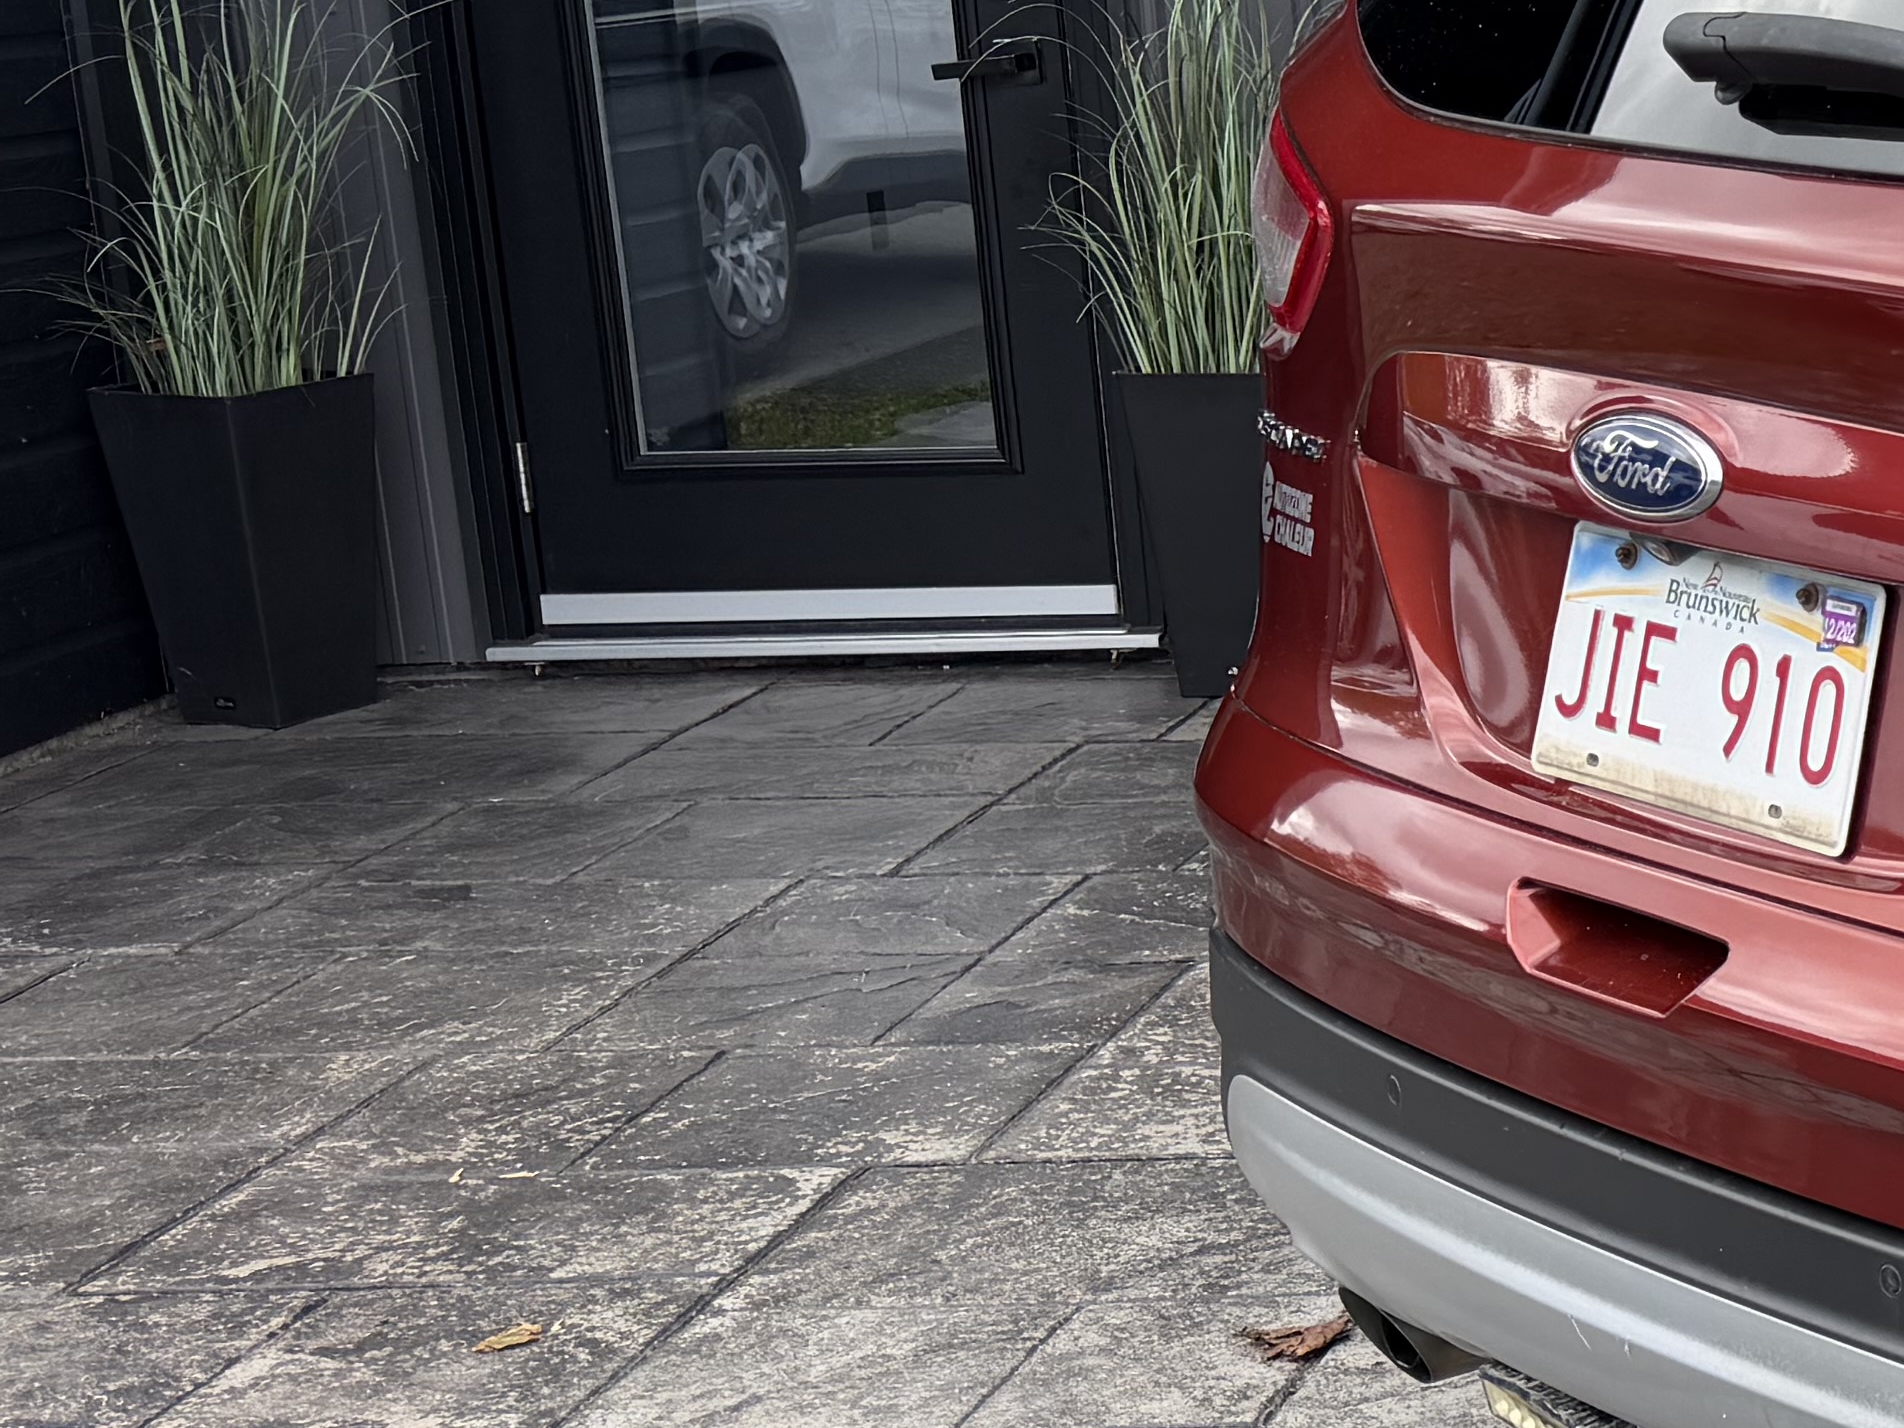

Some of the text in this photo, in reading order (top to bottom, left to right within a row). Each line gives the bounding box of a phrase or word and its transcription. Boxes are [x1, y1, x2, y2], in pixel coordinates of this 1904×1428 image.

[1593, 429, 1677, 497] Ford
[1665, 578, 1761, 625] Brunswick
[1673, 609, 1745, 635] CANADA
[1554, 608, 1846, 786] JIE 910
